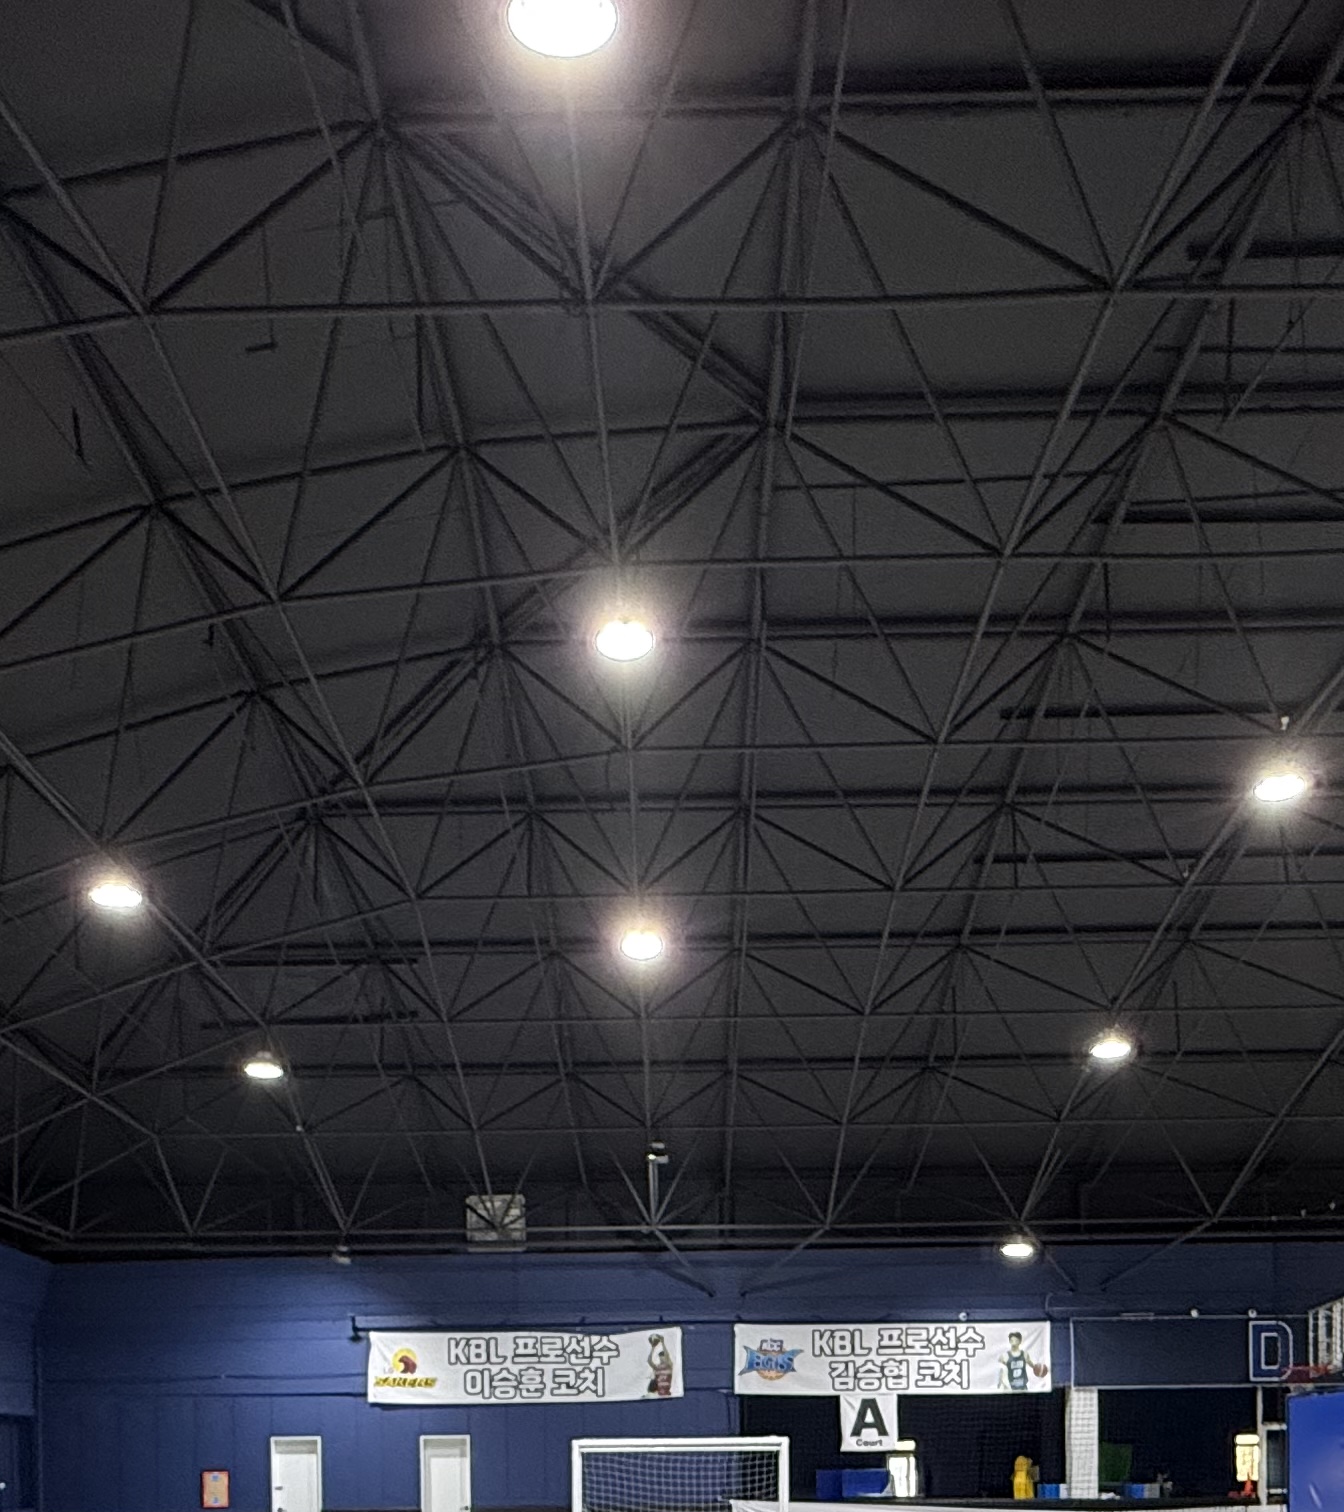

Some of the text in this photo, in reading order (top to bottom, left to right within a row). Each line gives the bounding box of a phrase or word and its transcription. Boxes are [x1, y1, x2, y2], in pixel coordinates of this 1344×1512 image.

[448, 1335, 620, 1366] KBL 프로선수
[812, 1327, 985, 1357] KBL 프로선수
[464, 1367, 605, 1399] 이승훈 코치
[829, 1358, 970, 1391] 김승협 코치
[850, 1398, 889, 1437] A
